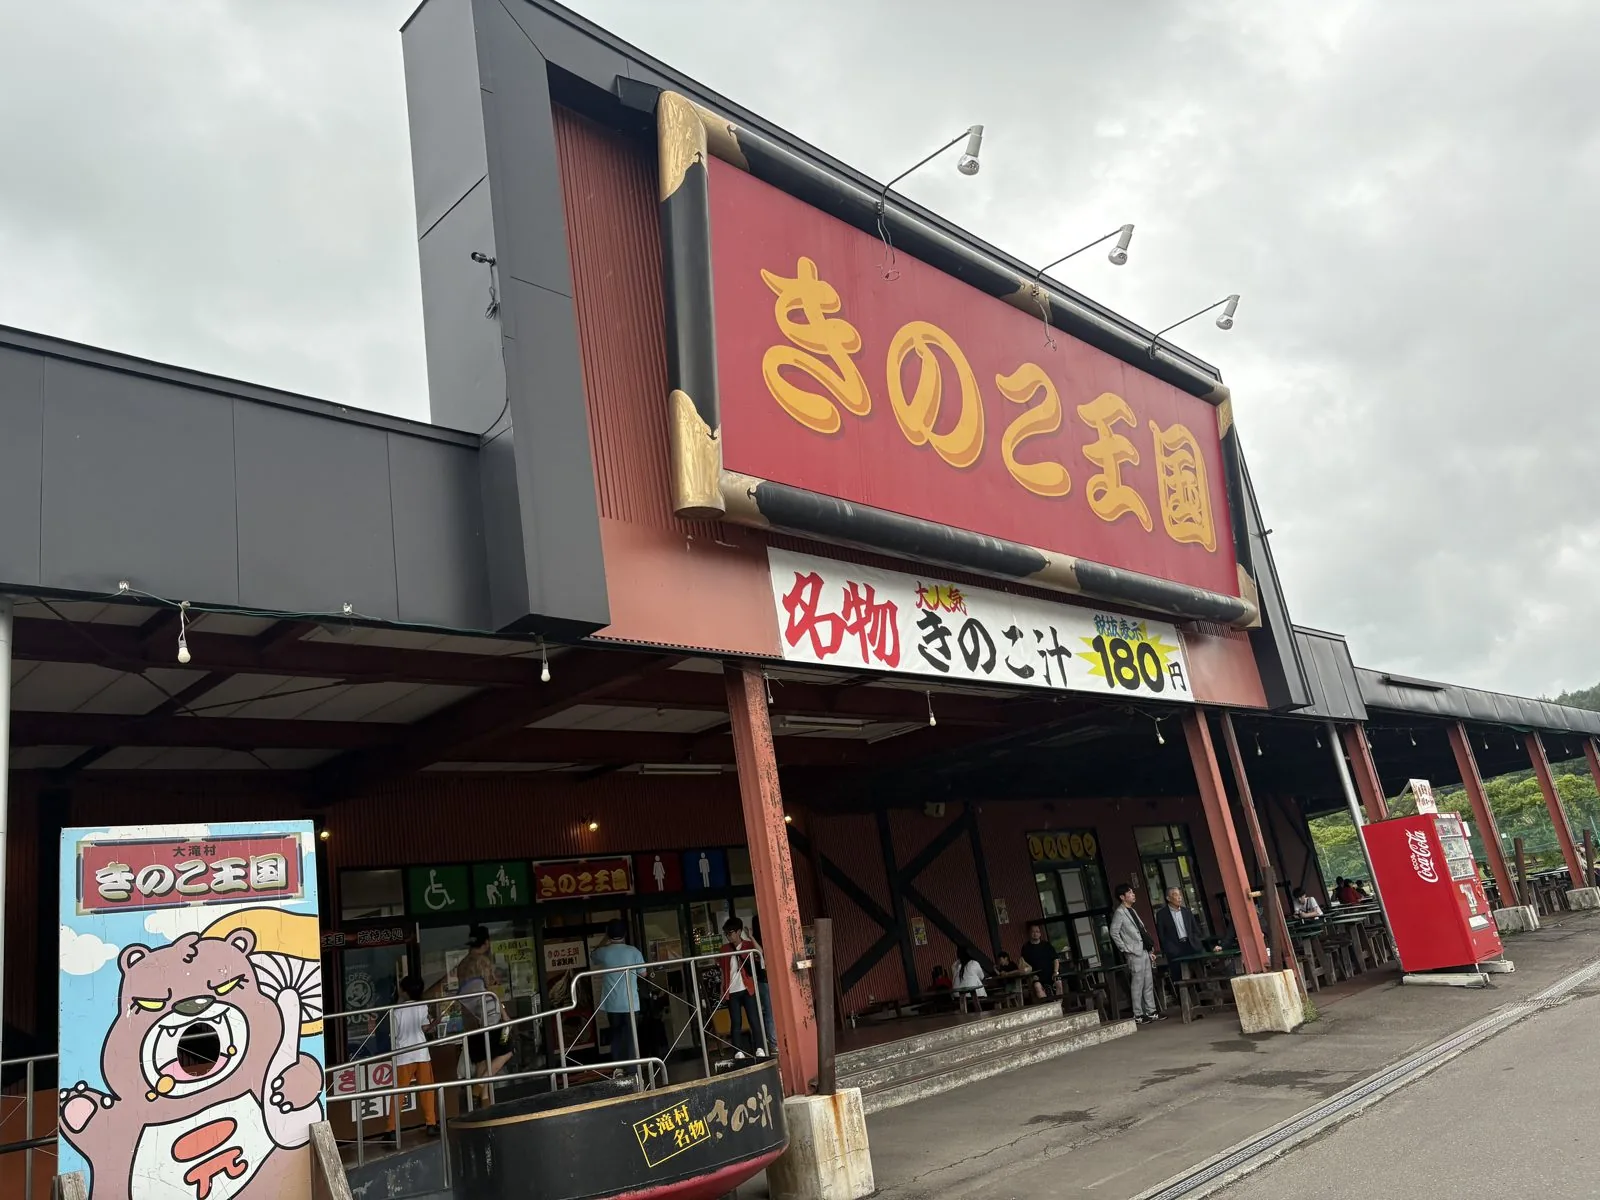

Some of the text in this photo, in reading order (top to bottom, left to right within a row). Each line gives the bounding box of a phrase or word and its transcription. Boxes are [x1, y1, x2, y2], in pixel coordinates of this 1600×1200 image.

[760, 256, 1217, 553] きのこ王国
[914, 580, 967, 615] 大人気
[781, 571, 901, 668] 名物
[1093, 614, 1143, 641] 税抜表示
[915, 608, 1073, 687] きのこ汁
[172, 845, 217, 857] 大滝村
[95, 853, 290, 902] きのこ王国
[539, 868, 628, 898] きのこ王国
[638, 1104, 689, 1144] 大滝村
[706, 1083, 774, 1140] きのこ汁
[672, 1119, 706, 1148] 名物
